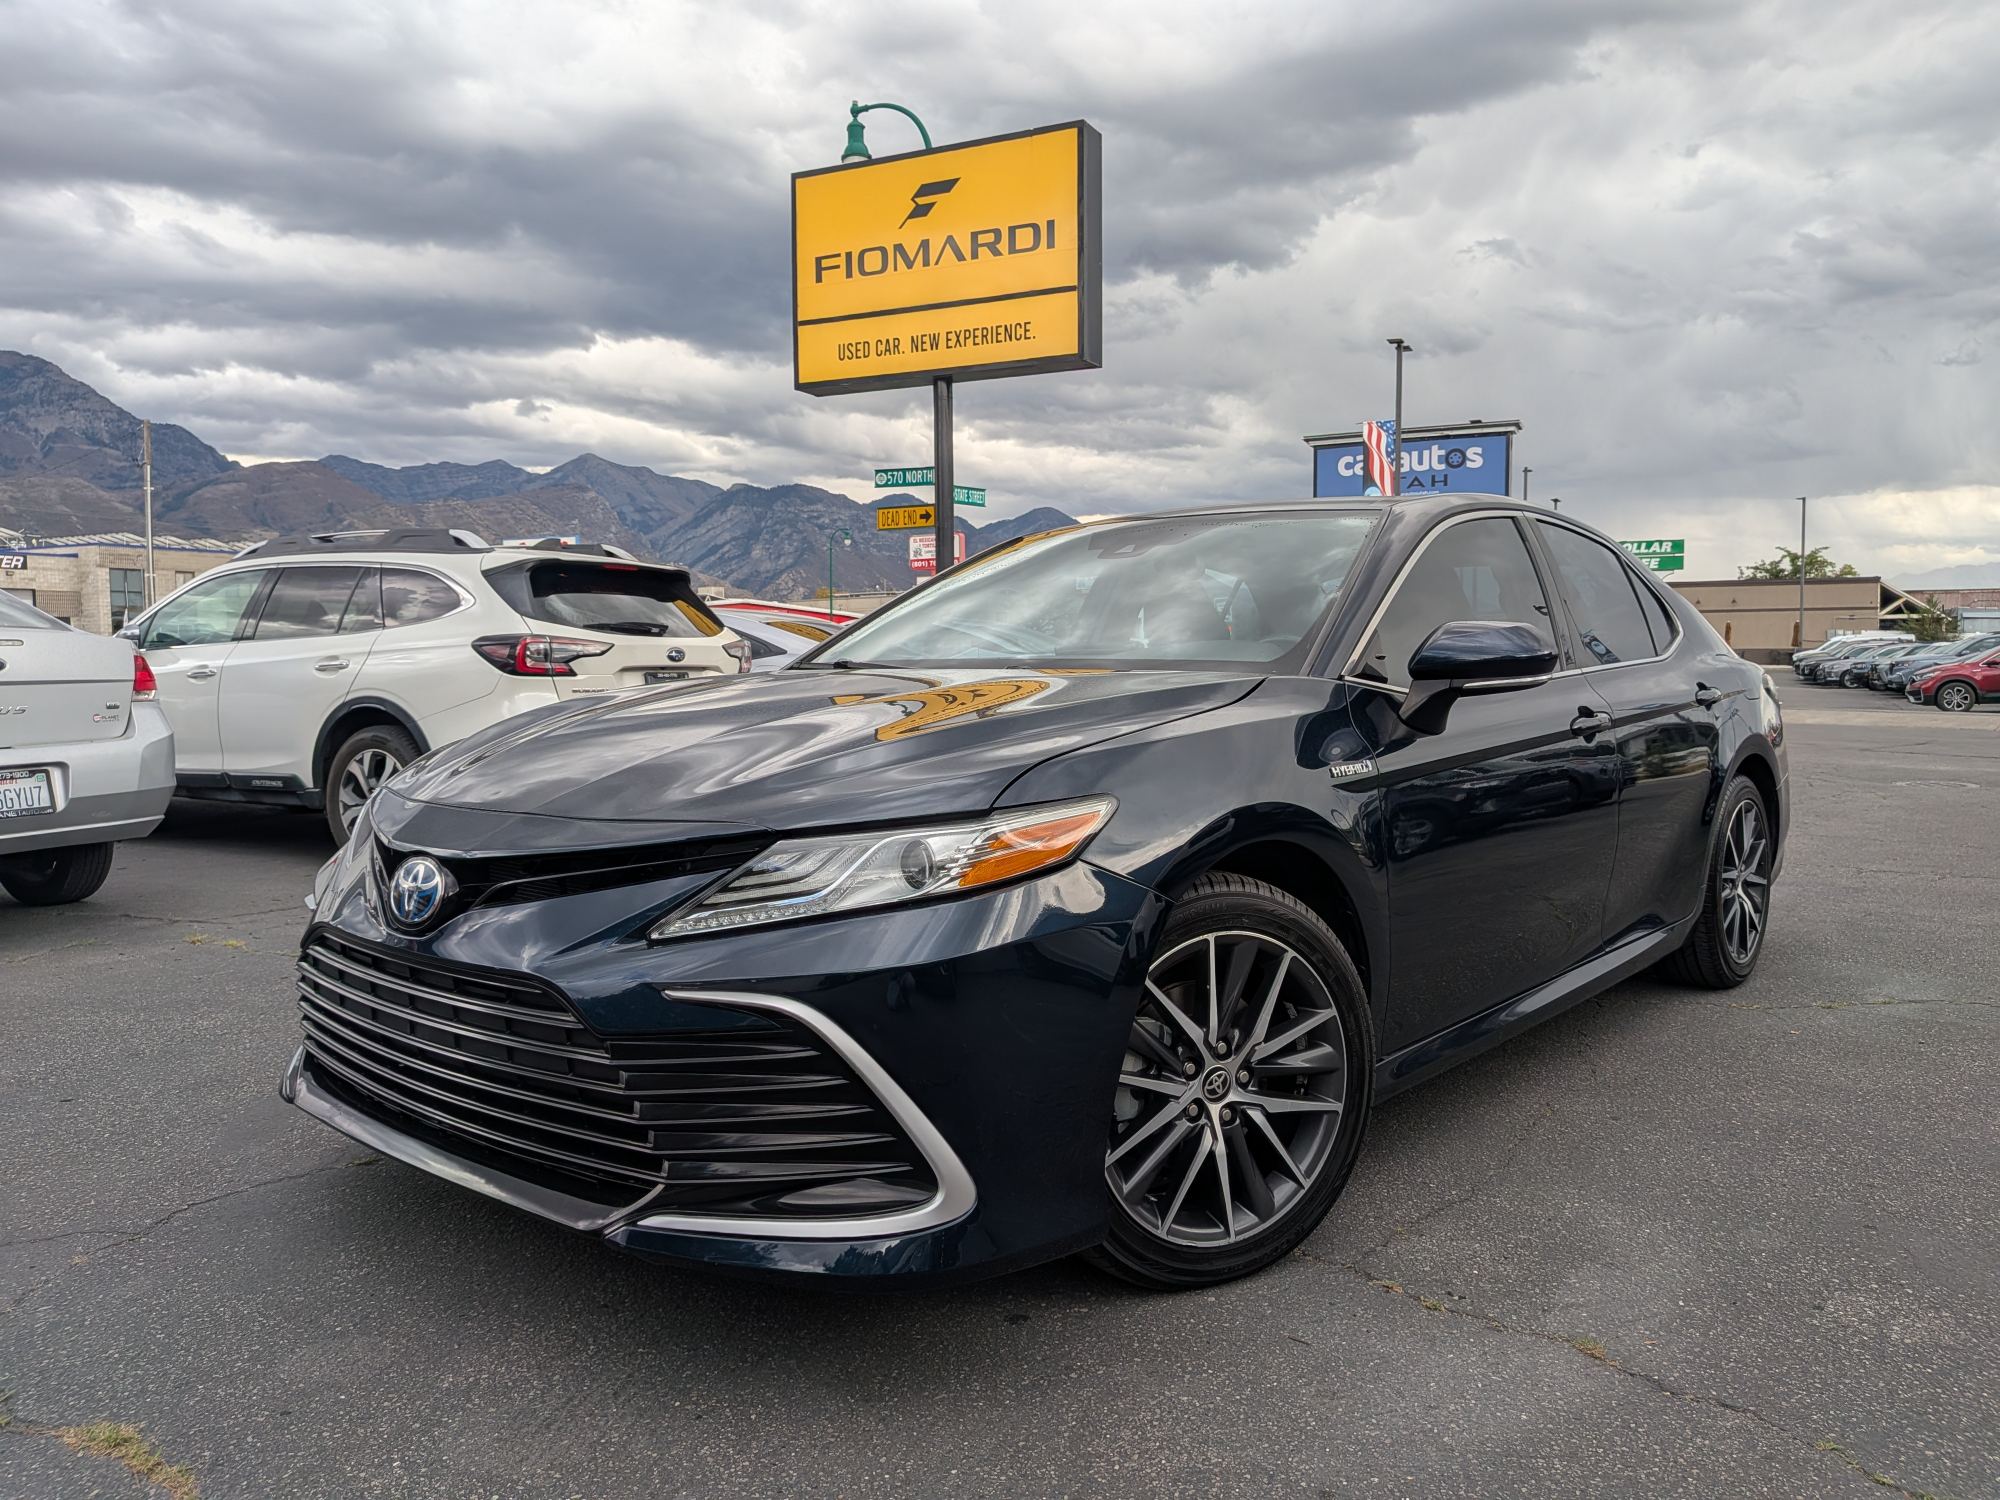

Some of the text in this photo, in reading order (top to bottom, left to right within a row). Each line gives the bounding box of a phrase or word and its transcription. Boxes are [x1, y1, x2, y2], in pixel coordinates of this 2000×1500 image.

[815, 219, 1055, 283] FIOMARDI
[838, 321, 1036, 361] USED CAR. NEW EXPERIENCE.
[887, 469, 933, 485] 570 NORTH
[954, 488, 985, 504] STATE STREET
[881, 509, 918, 527] DEAD END
[1622, 541, 1673, 554] OLLAR
[0, 770, 30, 780] 73-1900
[1330, 762, 1368, 778] HYBRID
